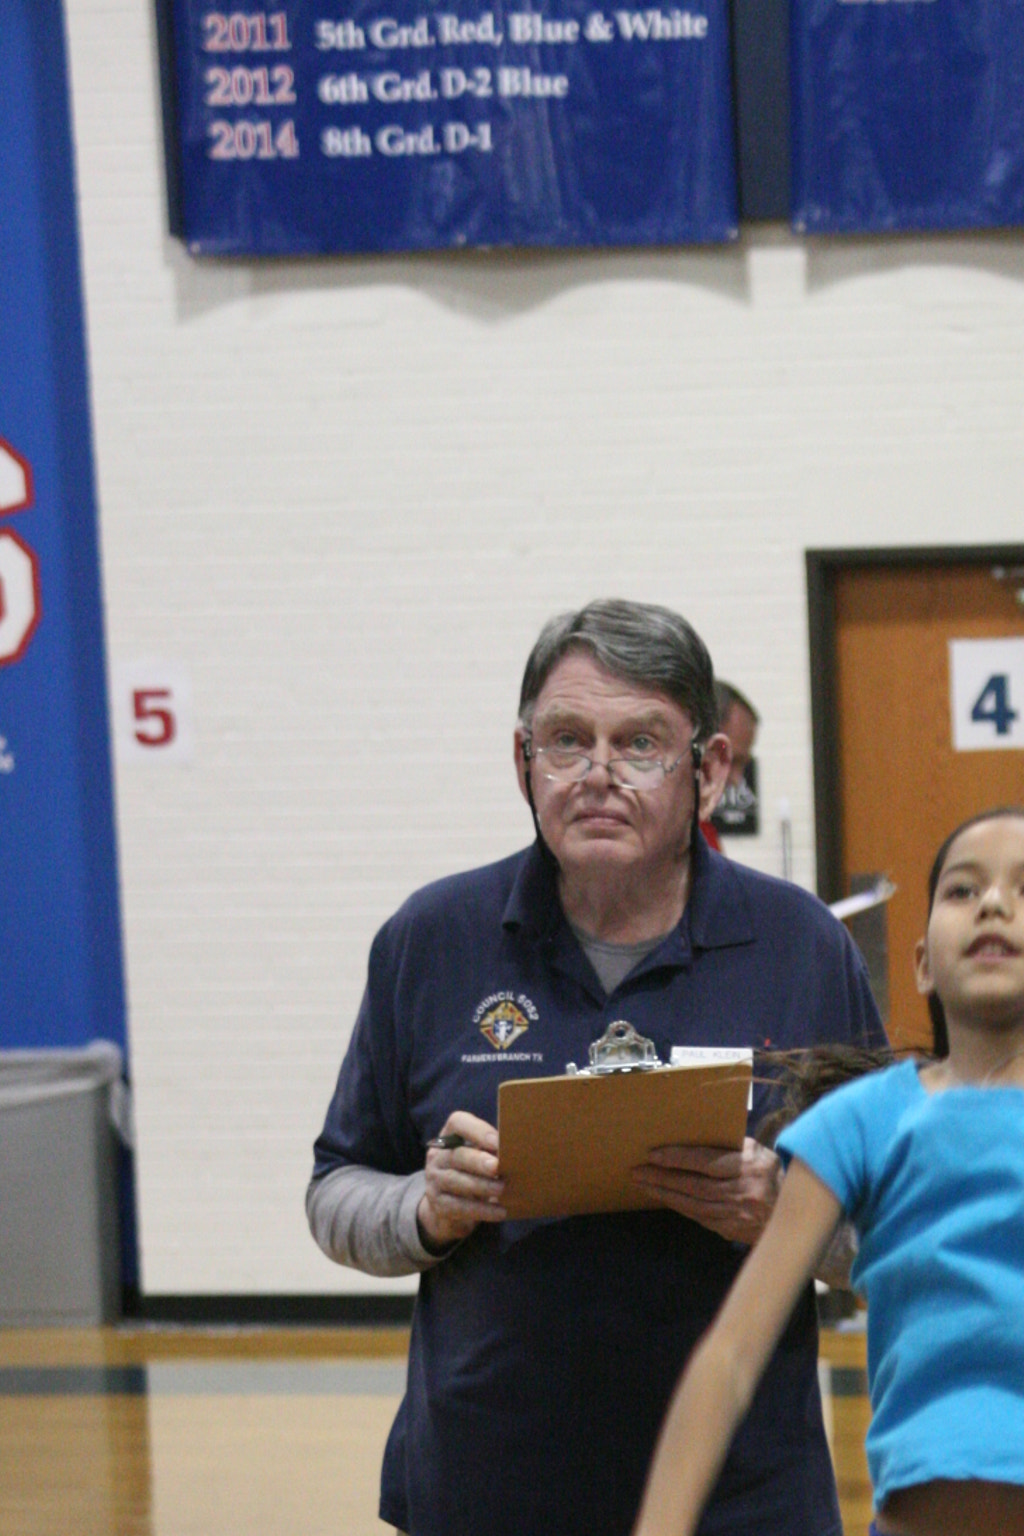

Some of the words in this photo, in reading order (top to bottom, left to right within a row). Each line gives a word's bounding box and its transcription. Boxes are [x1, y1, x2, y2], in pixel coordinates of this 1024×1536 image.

[204, 11, 291, 52] 2011
[315, 18, 366, 51] 5th
[369, 17, 436, 49] Grd.
[437, 12, 503, 46] Red,
[508, 12, 579, 44] Blue
[584, 10, 613, 43] &
[615, 8, 708, 41] White
[206, 64, 296, 106] 2012
[318, 72, 368, 105] 6th
[371, 70, 438, 103] Grd.
[440, 66, 492, 98] D-2
[498, 66, 569, 98] Blue
[208, 118, 300, 160] 2014
[321, 125, 372, 158] 8th
[375, 123, 441, 157] Grd.
[443, 121, 493, 154] D-1
[131, 686, 177, 748] 5
[968, 672, 1019, 737] 4
[472, 990, 516, 1024] COUNCIL
